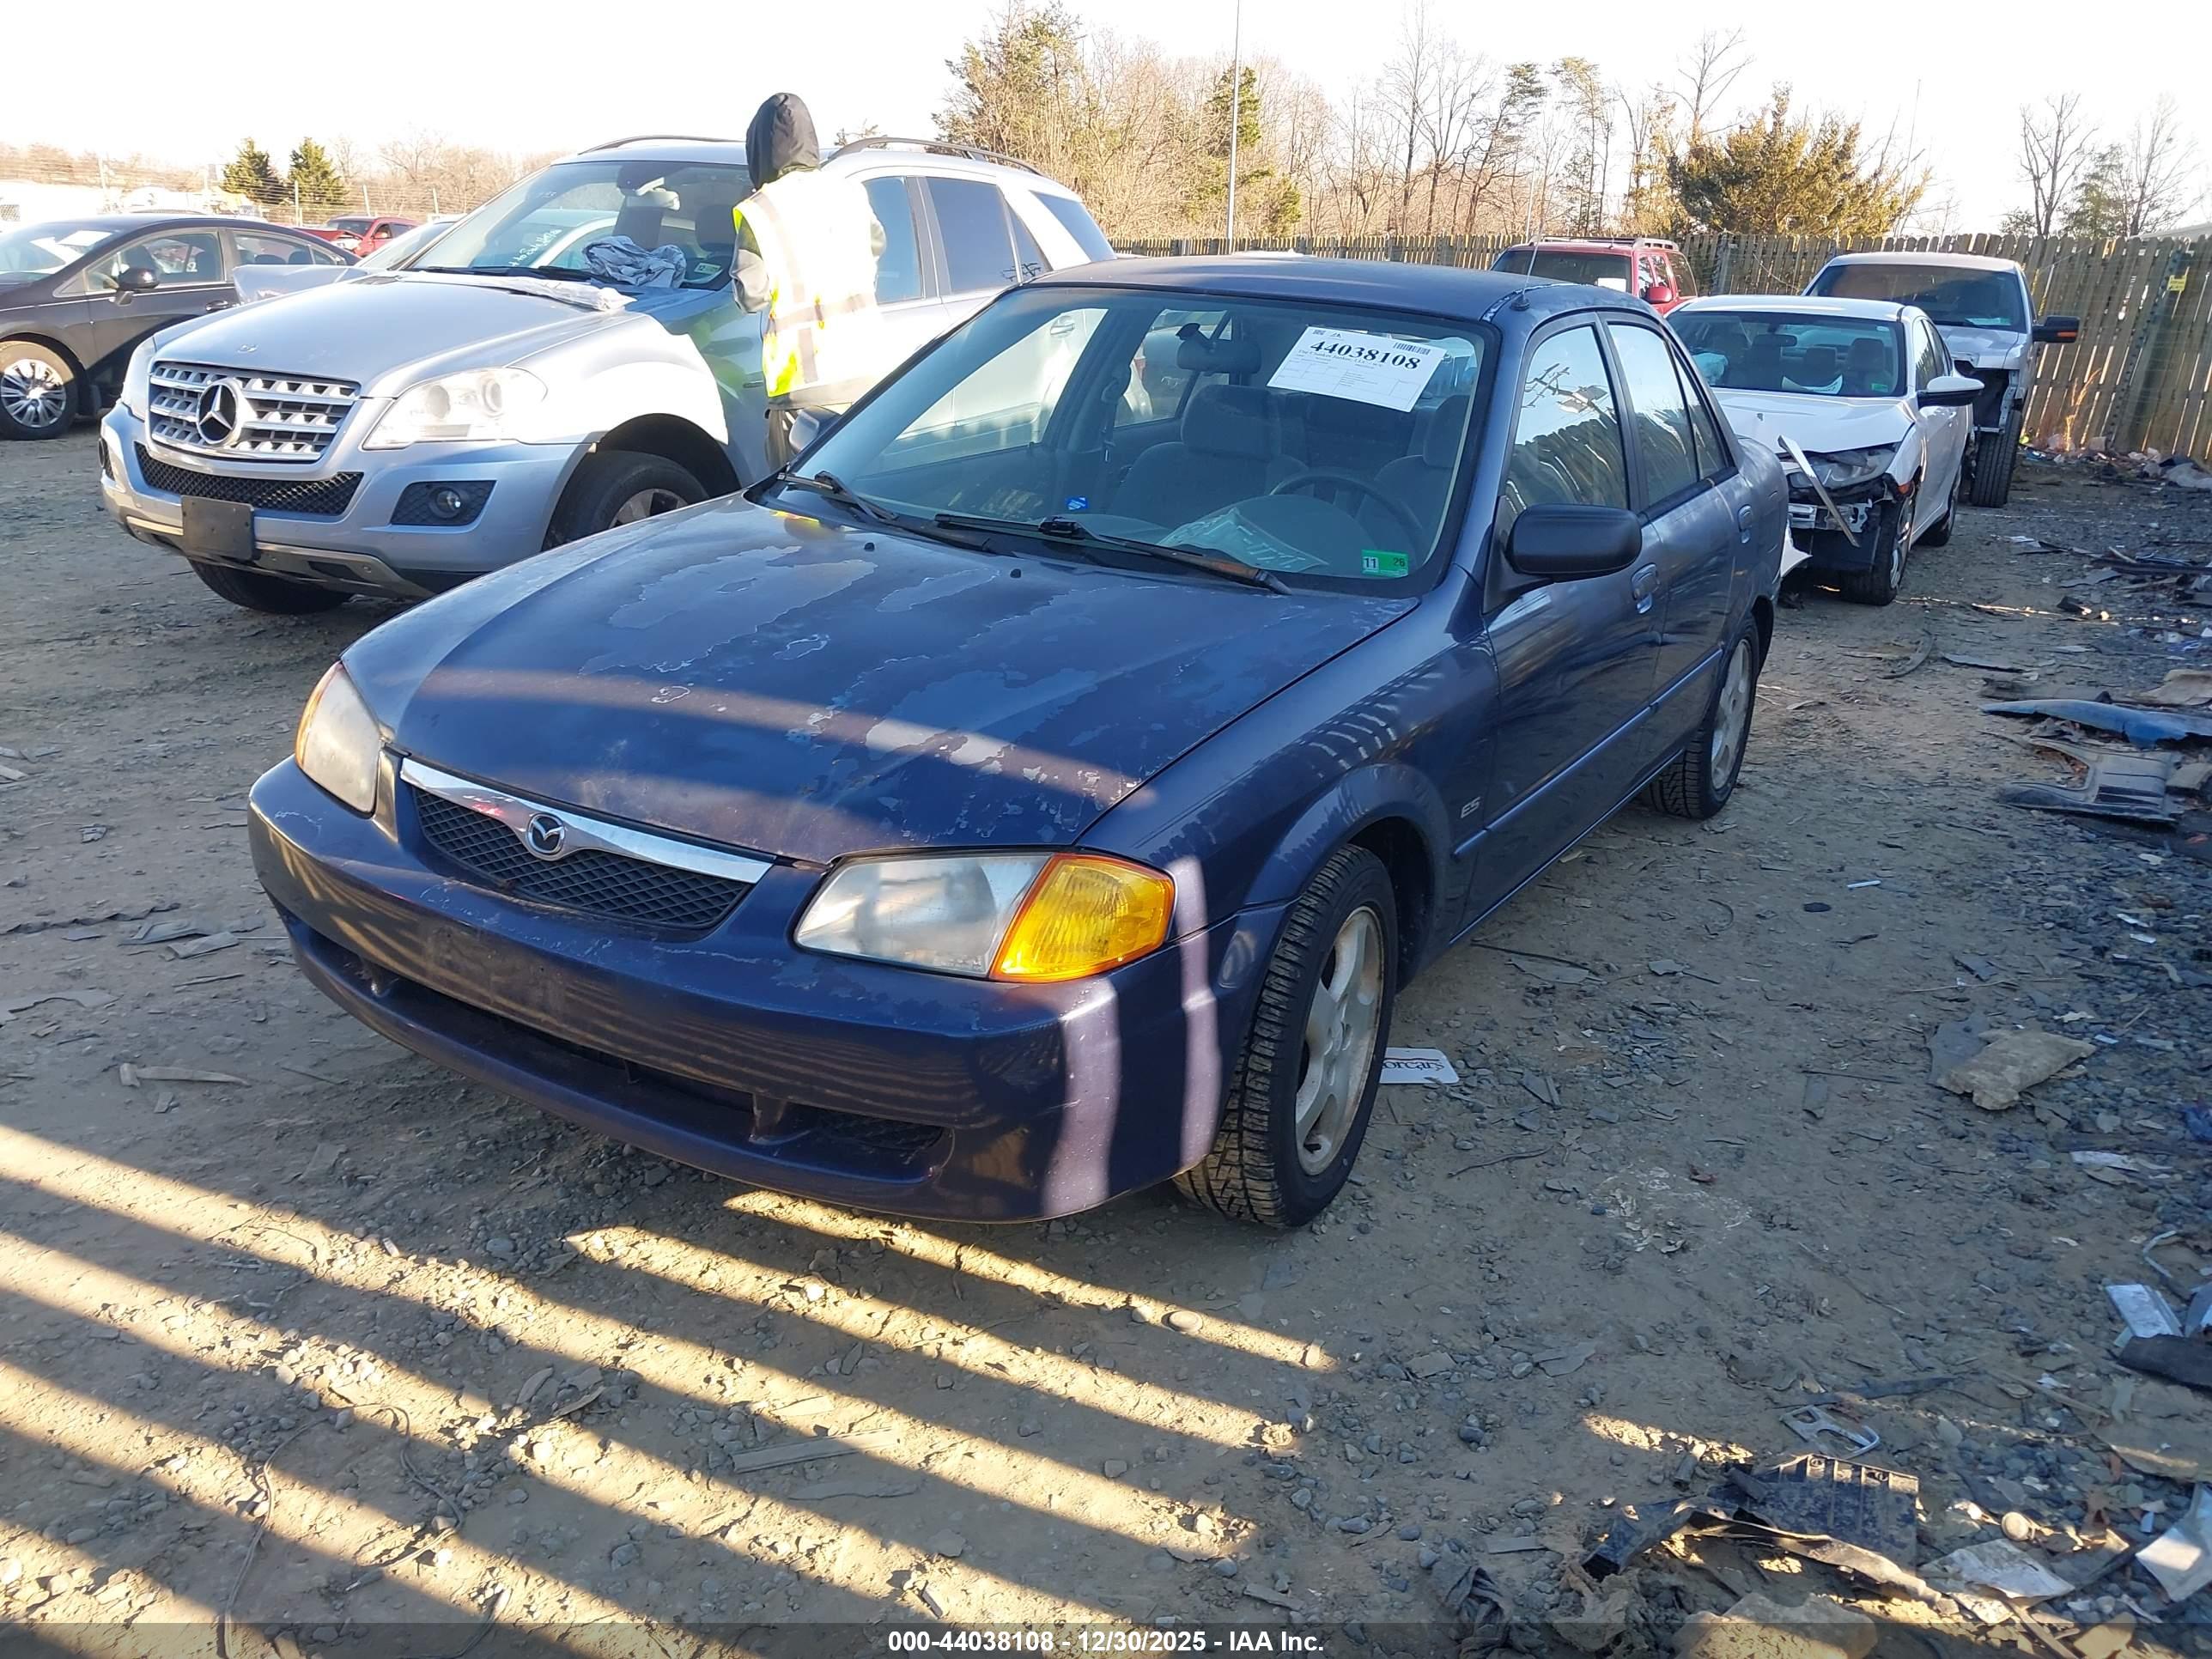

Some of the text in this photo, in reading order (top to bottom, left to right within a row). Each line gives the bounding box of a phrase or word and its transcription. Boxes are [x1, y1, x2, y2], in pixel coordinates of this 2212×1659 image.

[1310, 341, 1421, 369] 44038108
[1364, 557, 1376, 568] 11
[1460, 797, 1480, 818] ES
[1381, 1060, 1444, 1071] orcars
